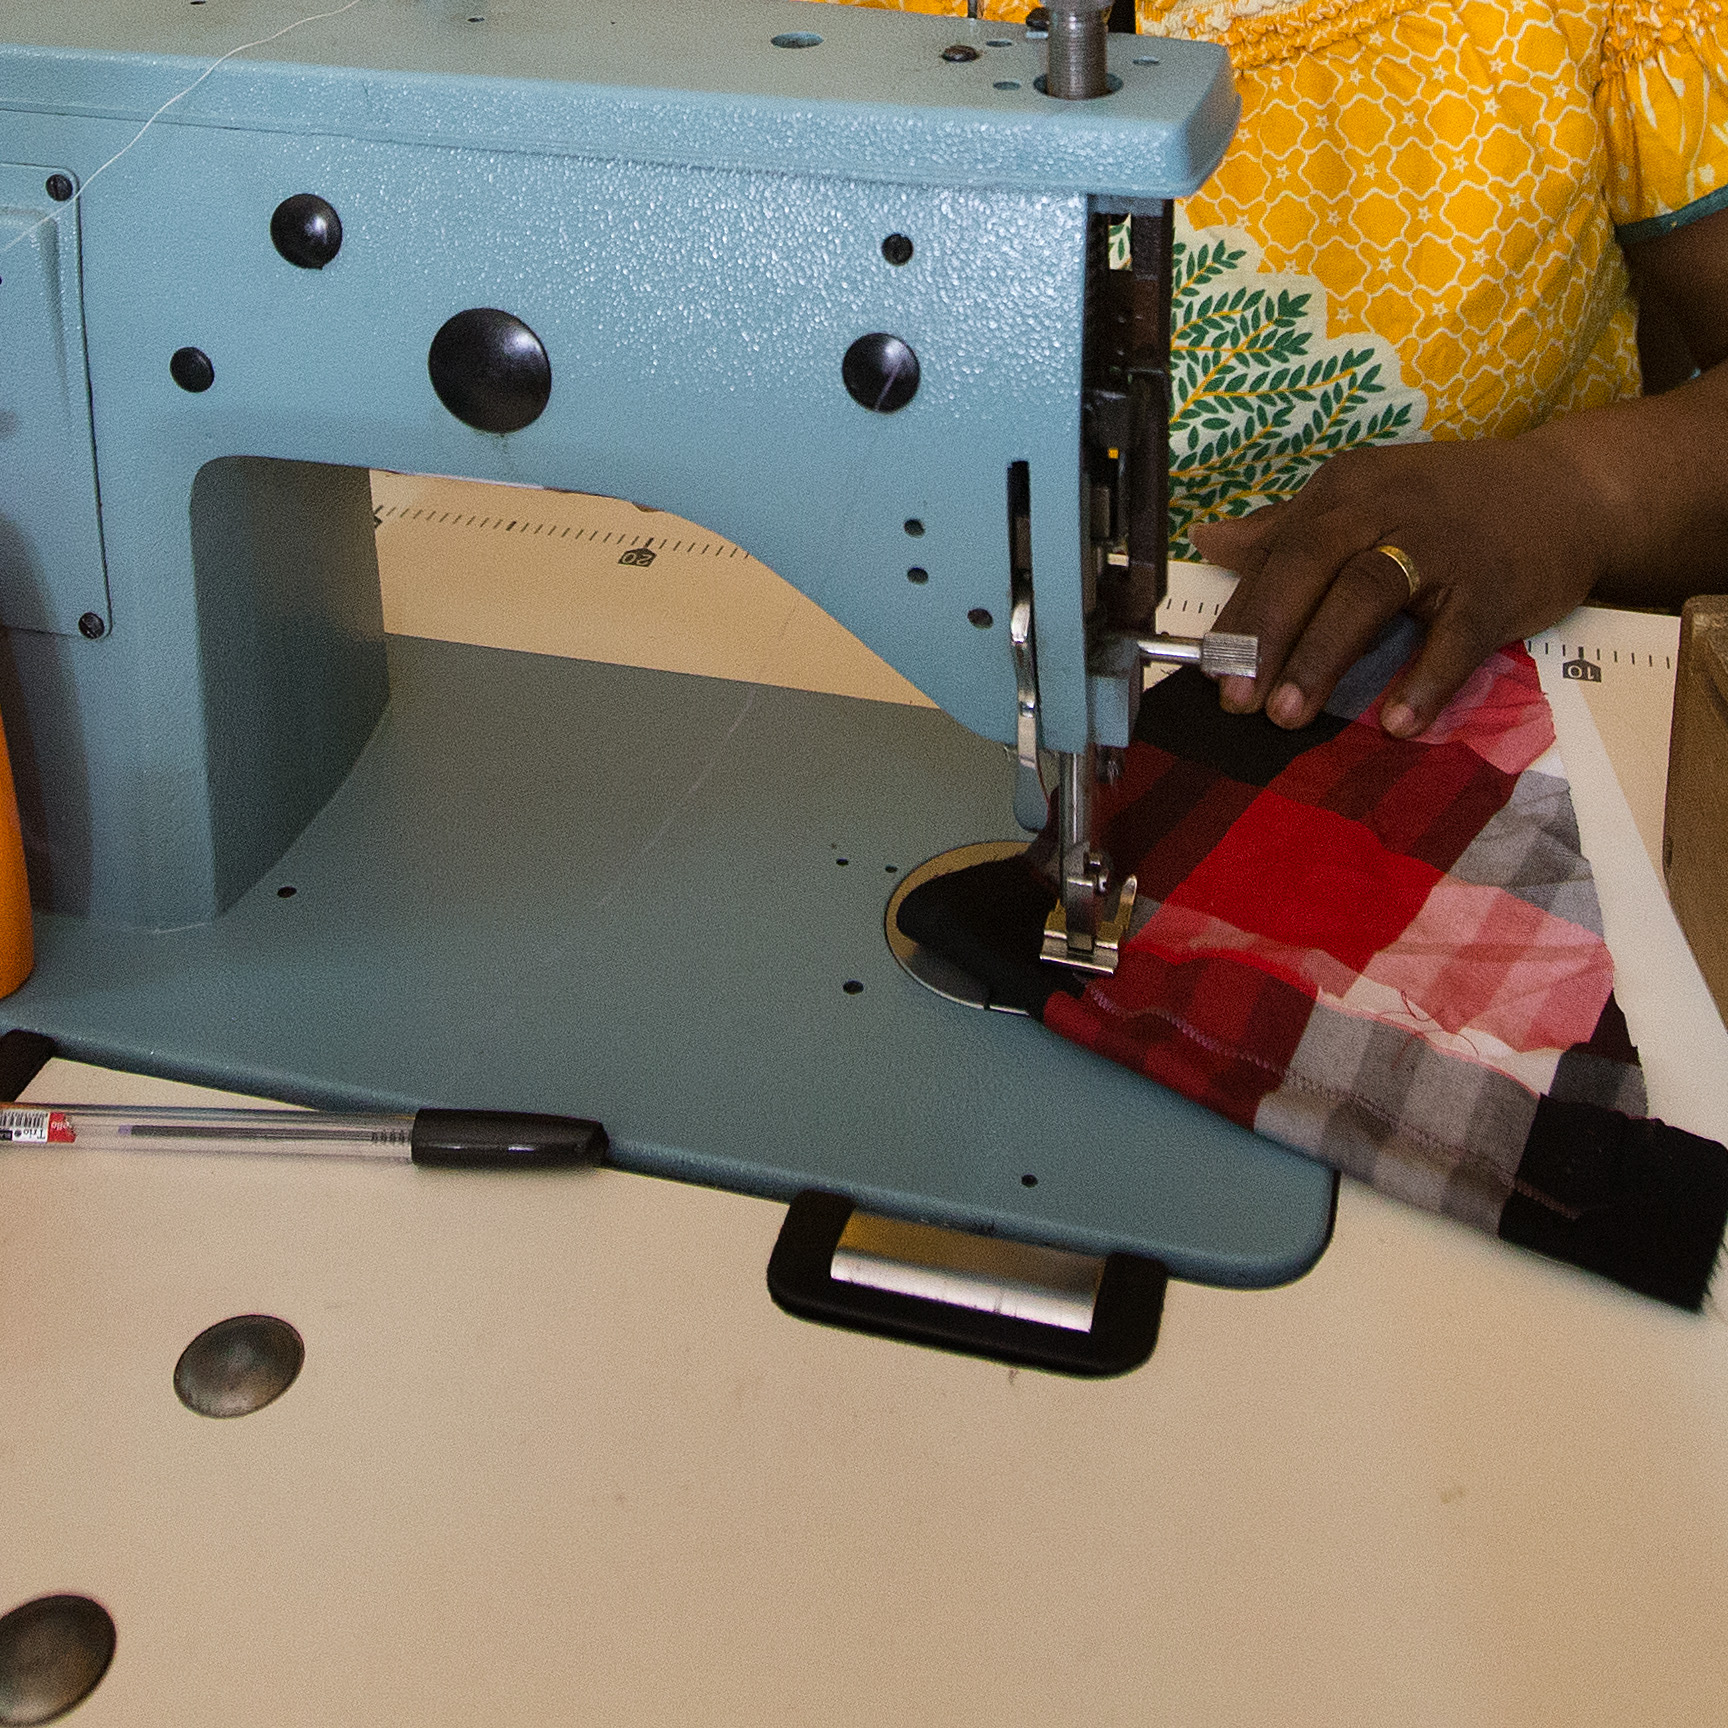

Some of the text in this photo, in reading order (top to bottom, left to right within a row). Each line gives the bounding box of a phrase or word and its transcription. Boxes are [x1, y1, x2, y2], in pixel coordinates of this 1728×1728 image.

[621, 551, 653, 566] 20
[1567, 665, 1594, 680] 10
[23, 1128, 46, 1139] Trio
